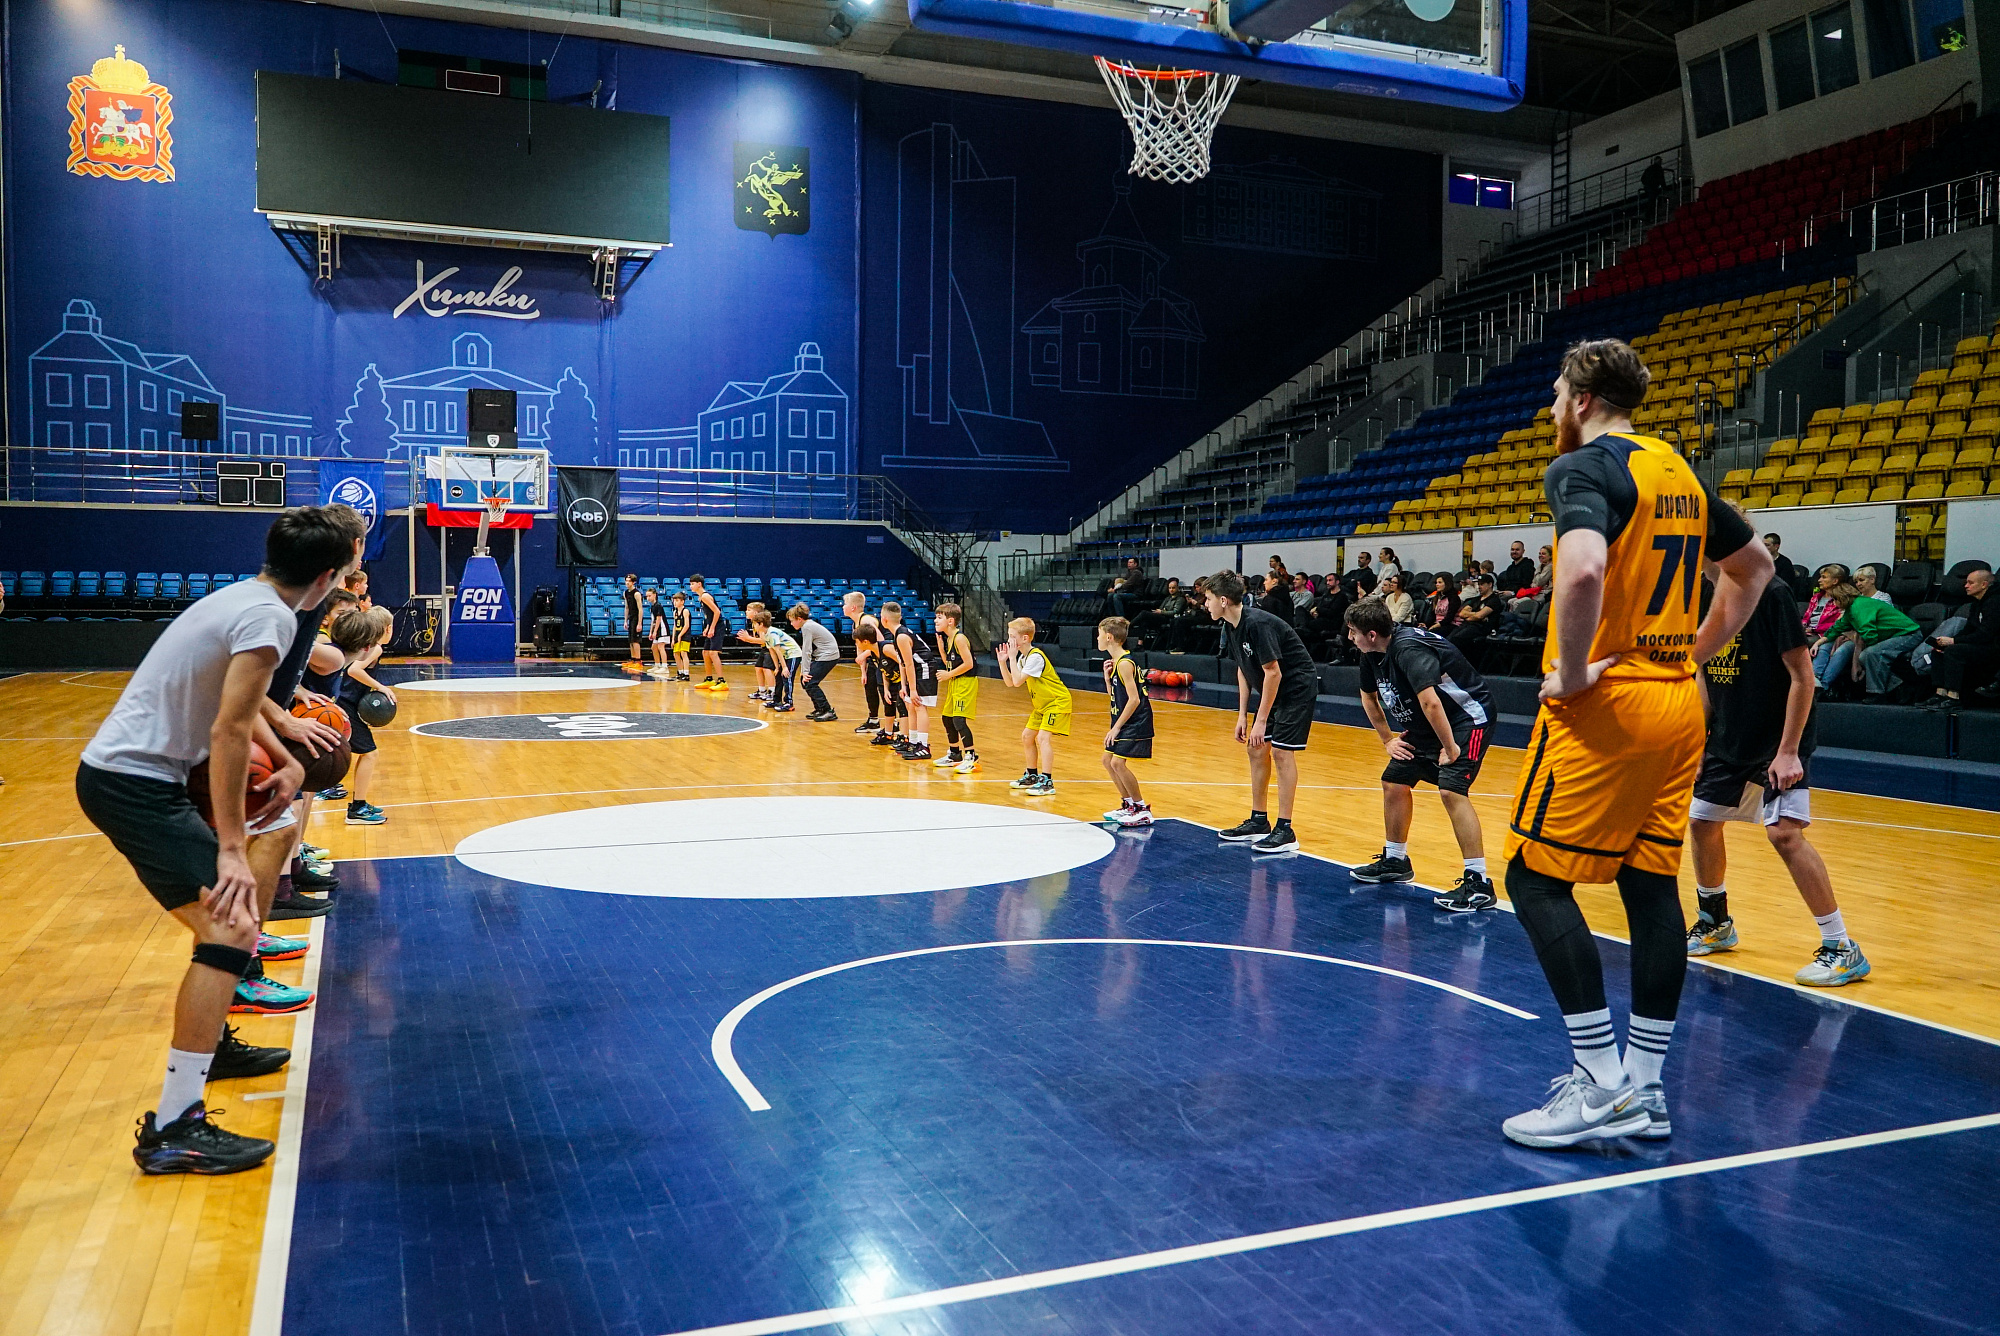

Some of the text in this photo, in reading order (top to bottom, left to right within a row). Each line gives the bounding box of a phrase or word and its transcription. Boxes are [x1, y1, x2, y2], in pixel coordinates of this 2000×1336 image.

[393, 259, 539, 319] Химки
[1655, 494, 1699, 519] ШАРАПОВ
[572, 511, 603, 523] РФБ
[1645, 535, 1701, 615] 71
[461, 588, 502, 604] FON
[461, 605, 502, 620] BET
